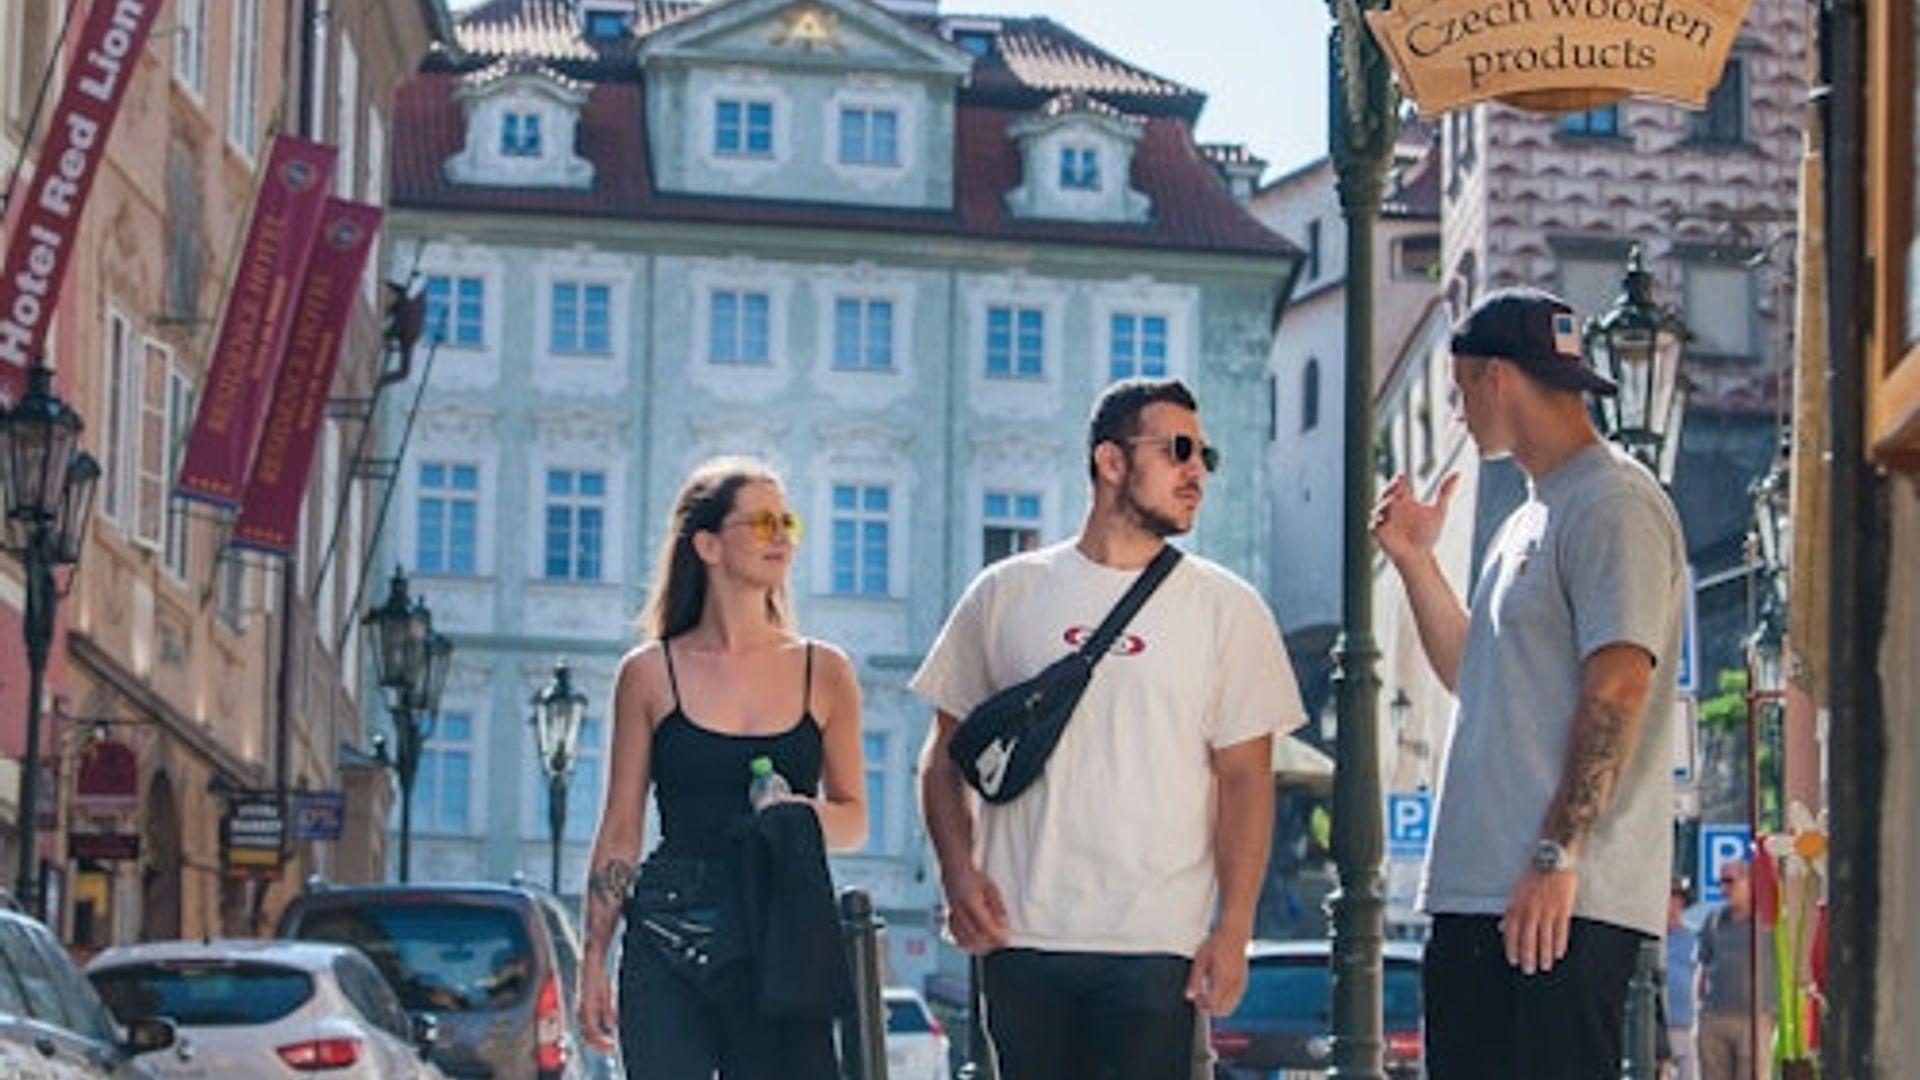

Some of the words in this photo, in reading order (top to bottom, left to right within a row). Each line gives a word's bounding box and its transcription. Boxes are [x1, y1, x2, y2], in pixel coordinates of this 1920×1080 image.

[1406, 0, 1531, 58] Czech
[1547, 0, 1714, 47] wooden
[1465, 33, 1656, 86] products
[0, 225, 62, 368] Hotel
[40, 112, 98, 217] Red
[78, 0, 144, 101] Lion
[1396, 801, 1423, 837] P
[1712, 836, 1744, 882] P
